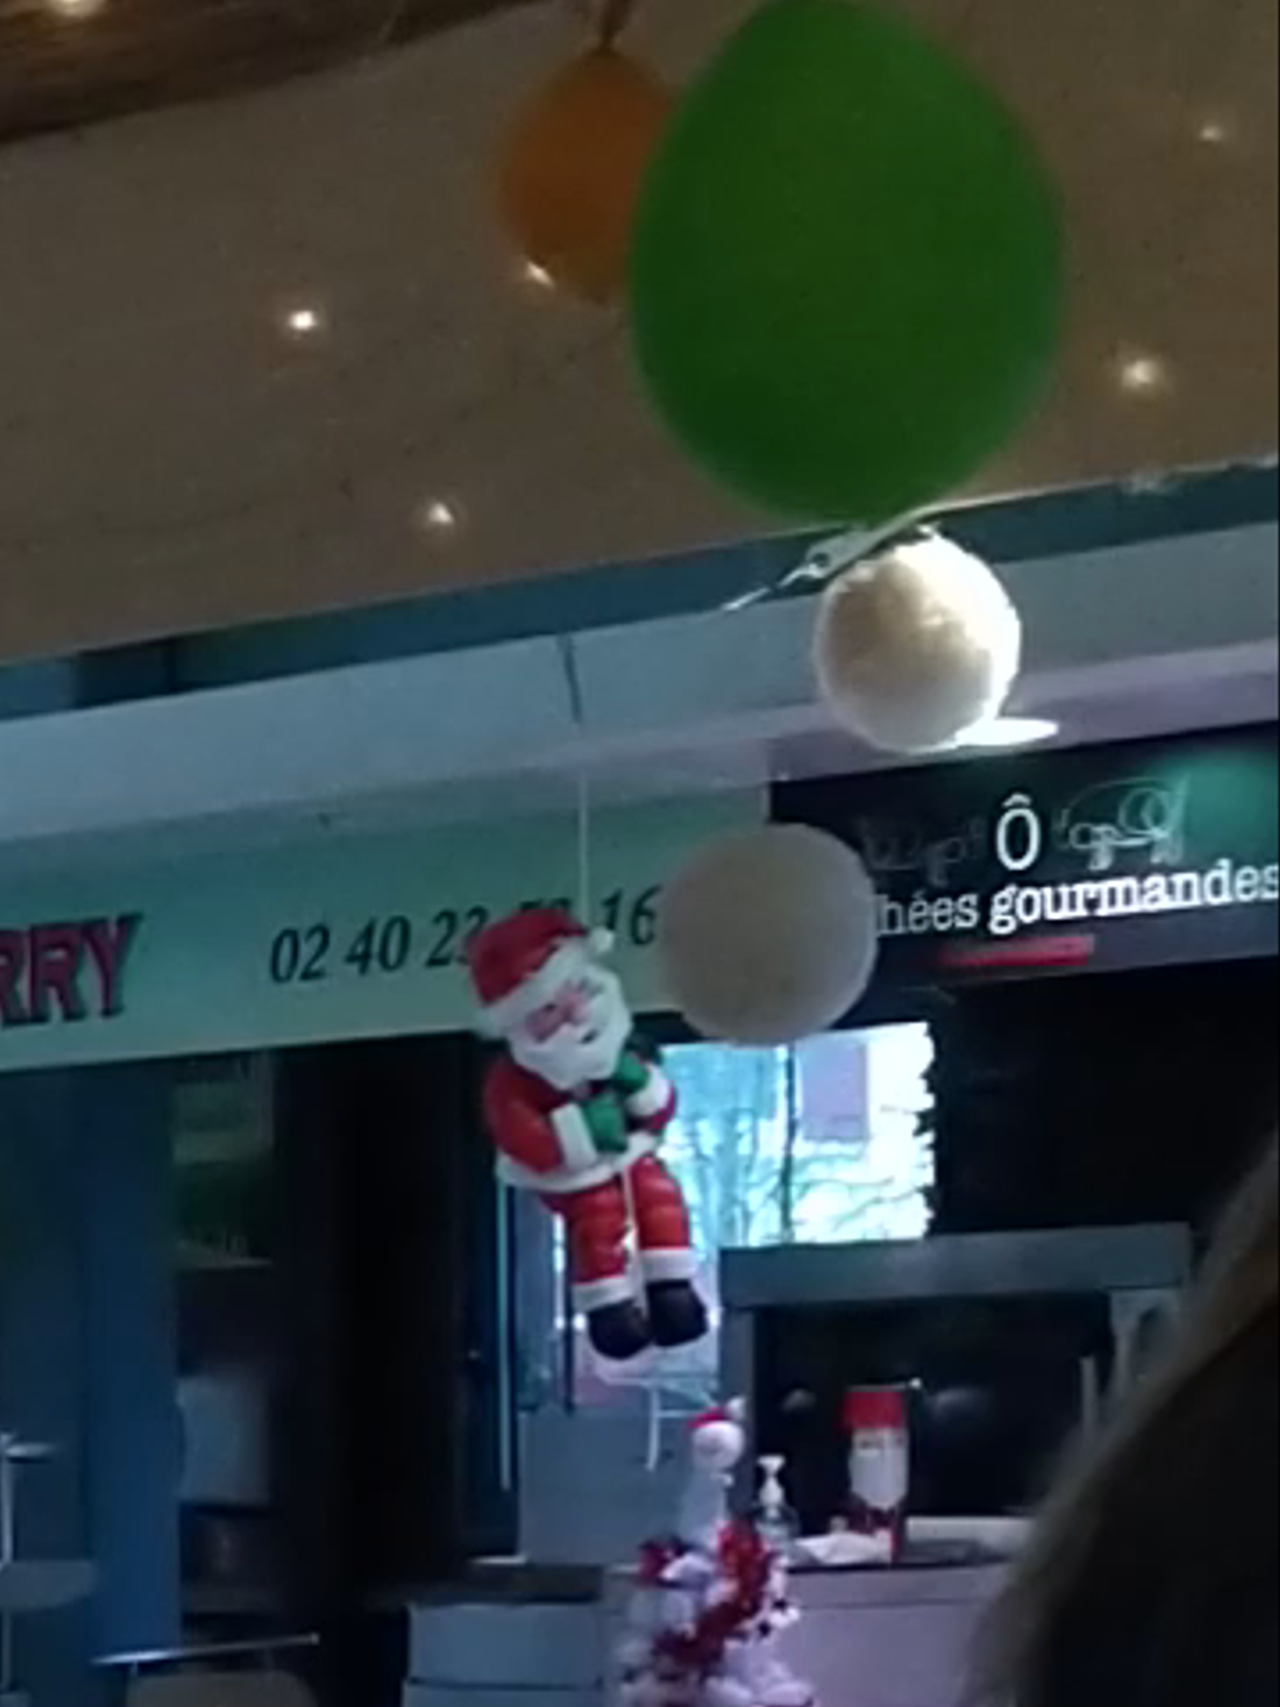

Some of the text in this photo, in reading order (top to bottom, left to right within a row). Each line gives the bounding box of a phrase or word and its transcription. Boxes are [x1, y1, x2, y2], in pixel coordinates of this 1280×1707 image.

[270, 924, 331, 983] 02
[345, 916, 412, 976] 40
[601, 887, 660, 946] 16
[987, 858, 1280, 935] gourmandes
